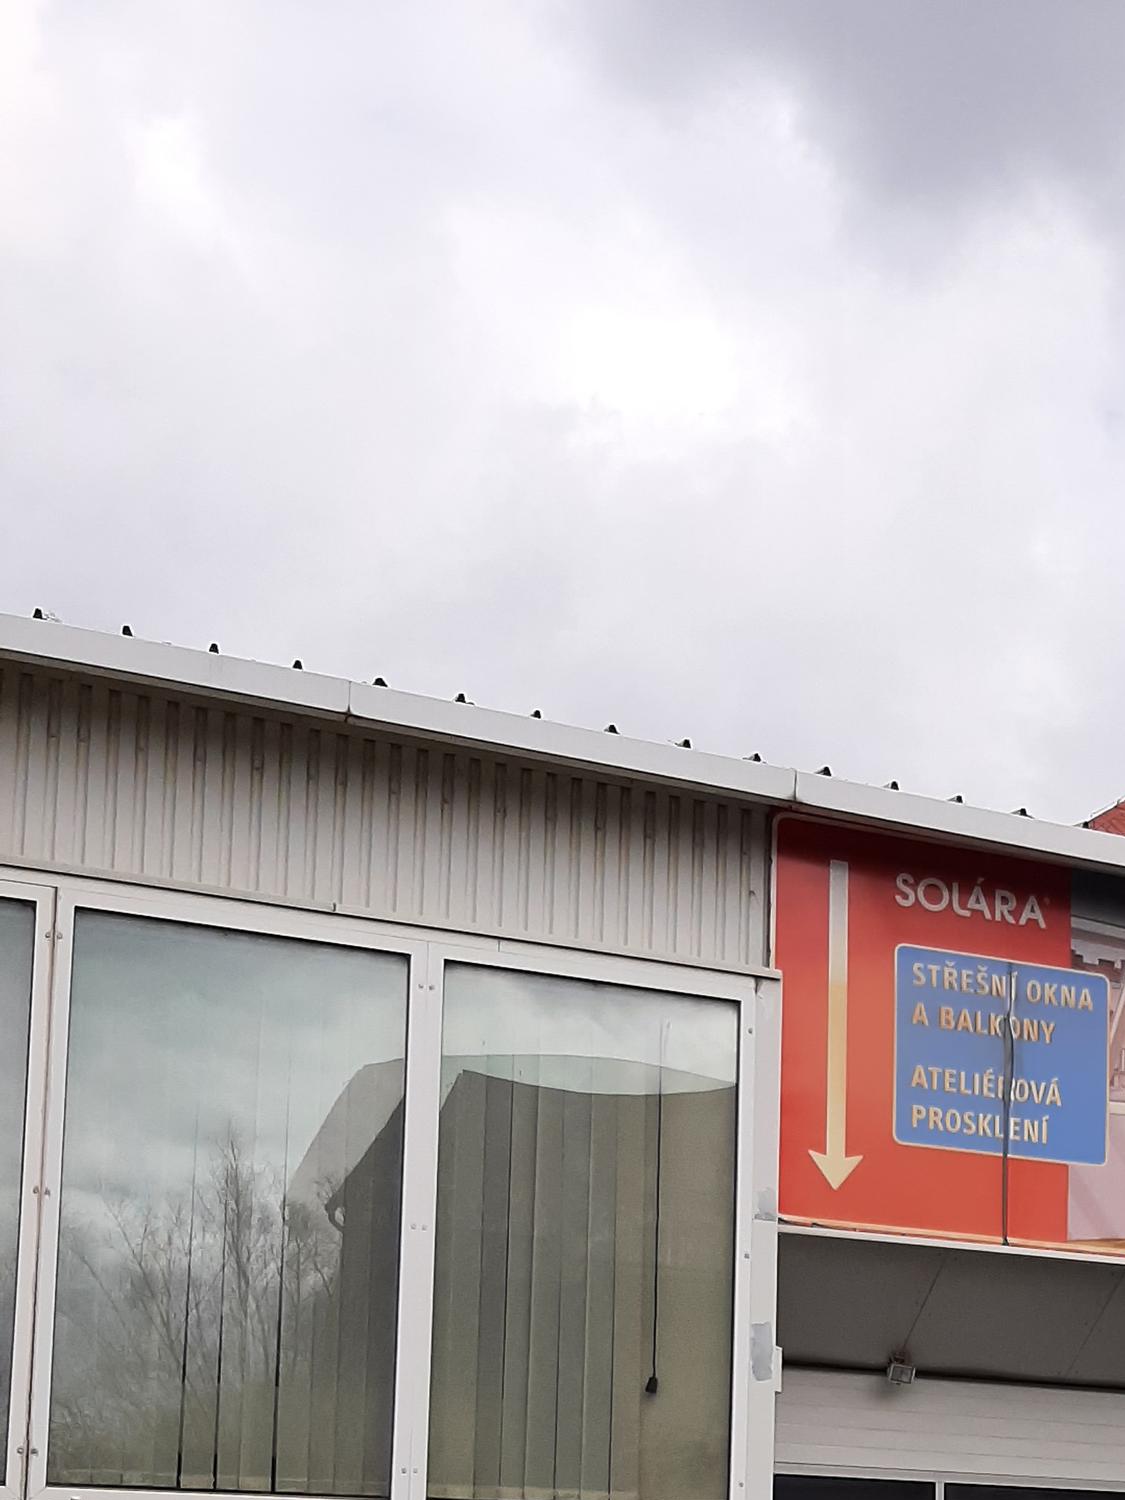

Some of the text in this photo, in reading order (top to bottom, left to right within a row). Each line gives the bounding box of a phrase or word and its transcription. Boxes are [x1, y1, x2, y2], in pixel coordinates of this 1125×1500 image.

[895, 872, 1047, 930] SOLÁRA
[912, 960, 1094, 1012] STŘEŠNÍ OKNA
[912, 1001, 1056, 1044] A BALKONY
[911, 1104, 1050, 1145] PROSKLENÍ
